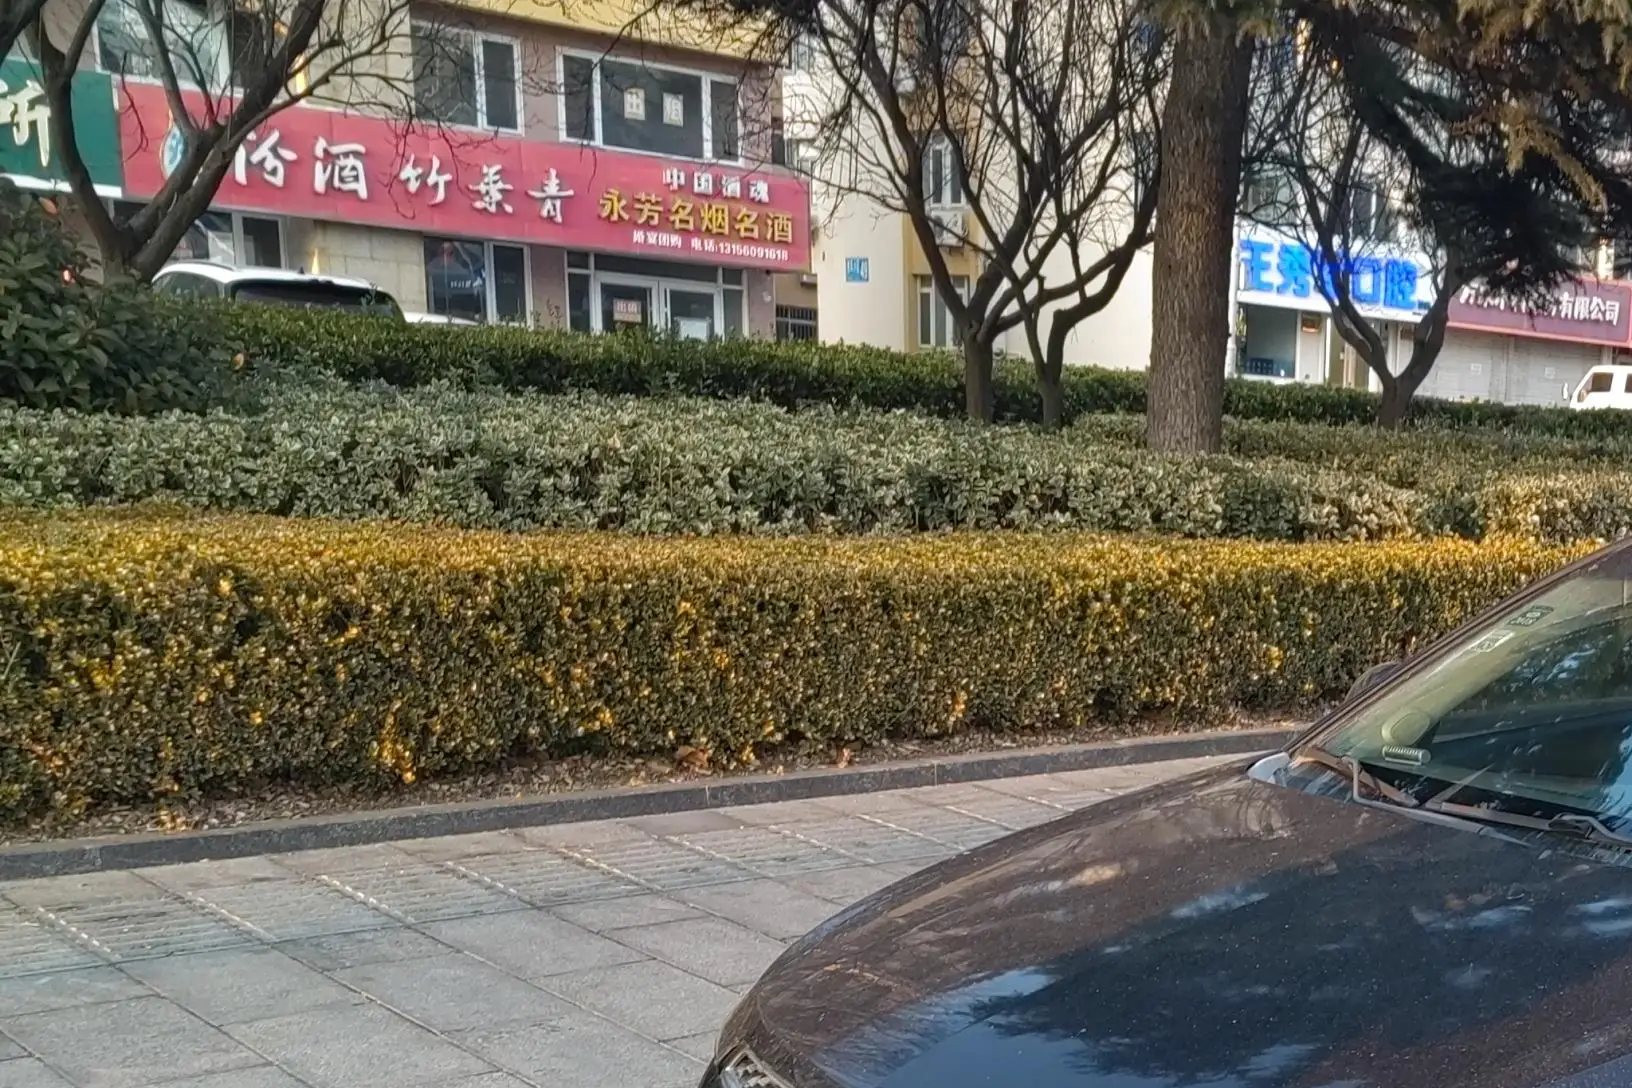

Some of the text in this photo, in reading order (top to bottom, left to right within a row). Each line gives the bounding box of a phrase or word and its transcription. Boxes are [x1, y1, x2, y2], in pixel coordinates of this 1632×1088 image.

[234, 128, 368, 200] 汾酒
[662, 167, 770, 203] 中国酒魂
[600, 188, 793, 244] 永芳名烟名酒
[1239, 238, 1418, 310] 王秀口腔
